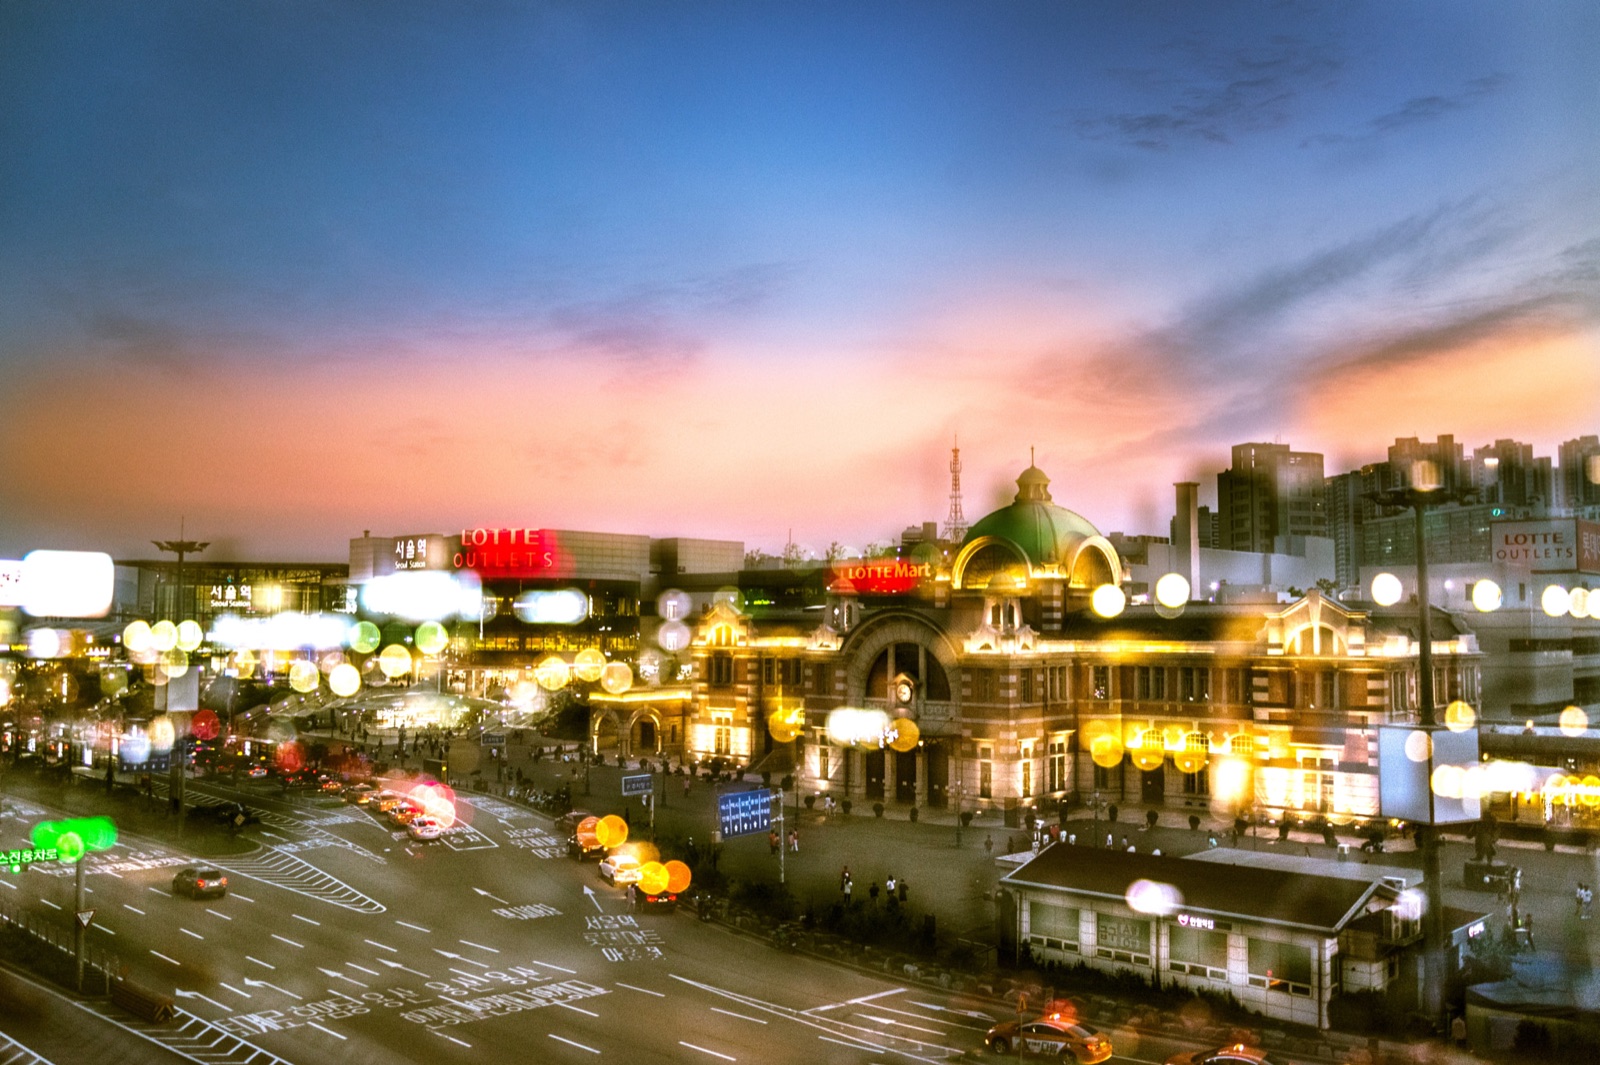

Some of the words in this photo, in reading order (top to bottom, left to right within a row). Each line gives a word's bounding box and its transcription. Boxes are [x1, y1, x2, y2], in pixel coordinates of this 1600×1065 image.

[462, 528, 539, 546] LOTTE
[1504, 532, 1563, 545] LOTTE
[395, 539, 426, 559] 서울역
[1496, 548, 1573, 560] OUTLETS
[395, 561, 408, 569] Seoul
[409, 560, 426, 568] Station
[453, 552, 553, 568] OUTLETS
[848, 566, 892, 579] LOTTE
[894, 562, 931, 578] Mart
[210, 585, 252, 600] 서울역
